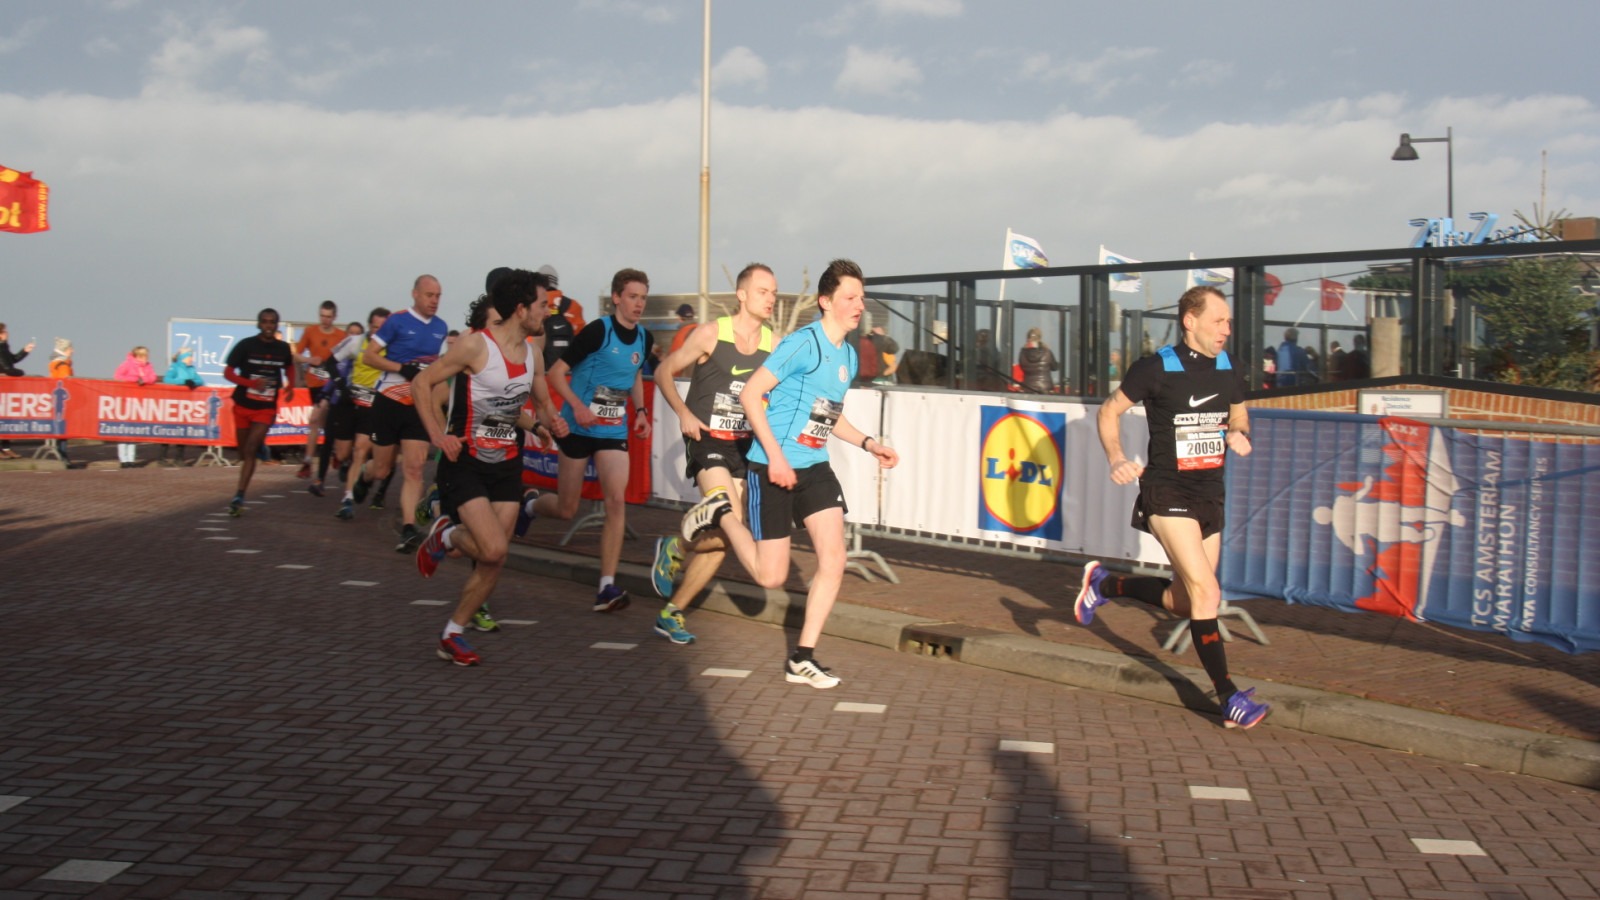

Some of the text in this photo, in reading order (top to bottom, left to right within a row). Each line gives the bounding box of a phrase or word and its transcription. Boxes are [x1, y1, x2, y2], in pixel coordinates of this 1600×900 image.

[0, 392, 53, 418] ERS
[31, 421, 52, 433] Run
[99, 423, 206, 438] Zandvoort Circuit Run
[1187, 441, 1222, 455] 20094
[1525, 504, 1542, 595] CONSULTANCY
[1492, 504, 1517, 632] MARATHON
[1471, 588, 1493, 627] TCS
[1520, 599, 1537, 632] TATA
